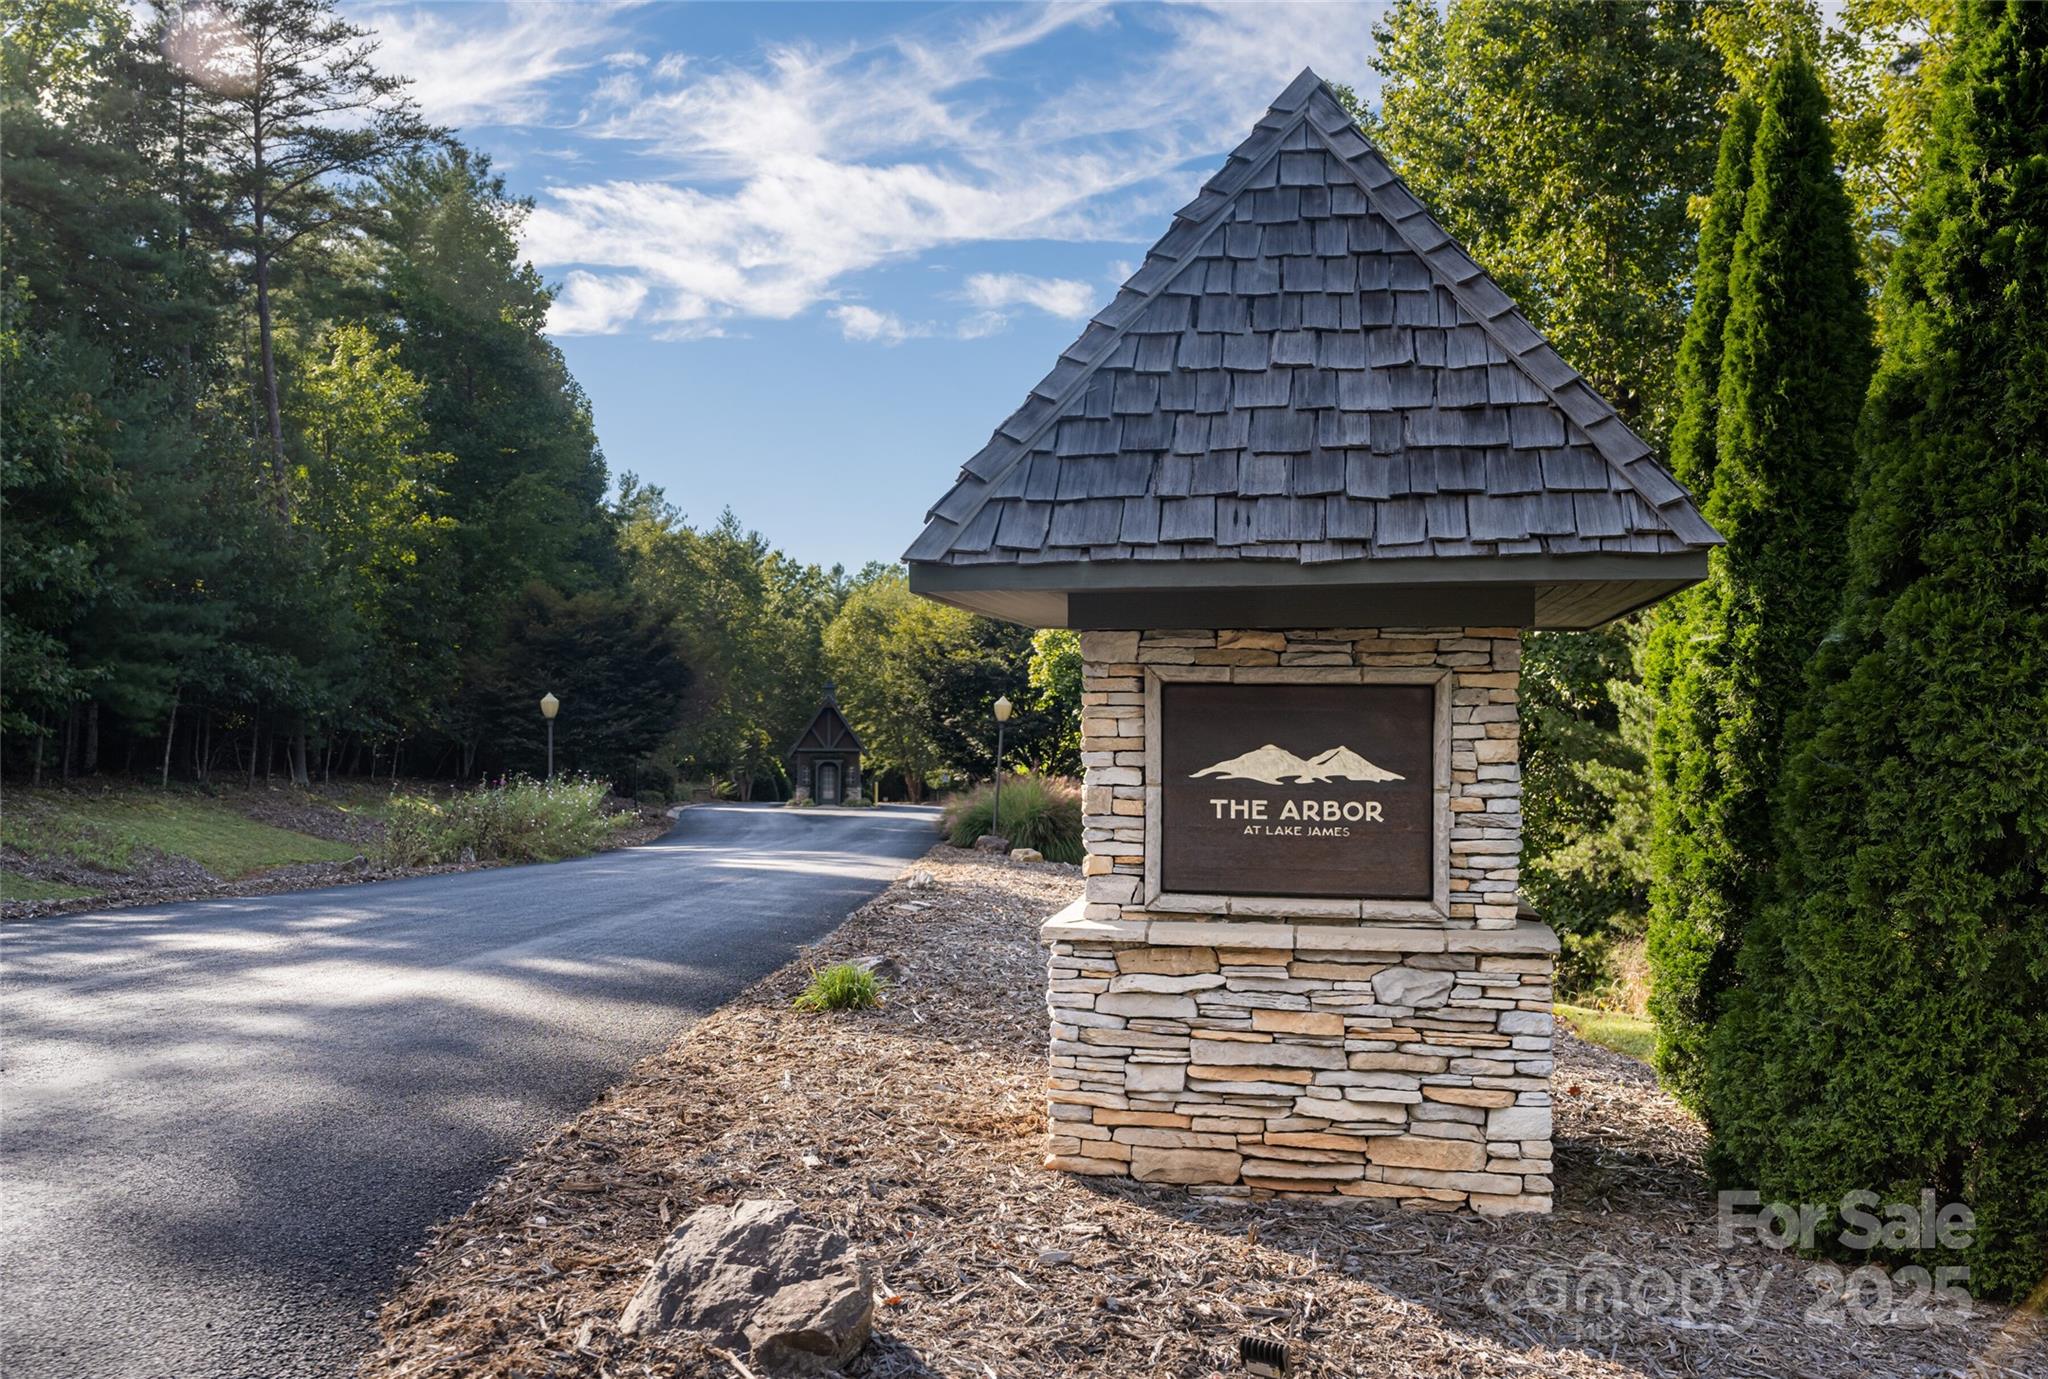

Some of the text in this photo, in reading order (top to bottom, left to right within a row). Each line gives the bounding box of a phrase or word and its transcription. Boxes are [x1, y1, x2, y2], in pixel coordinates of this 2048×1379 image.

[1209, 799, 1385, 823] THE ARBOR
[1243, 825, 1351, 837] AT LAKE JAMES
